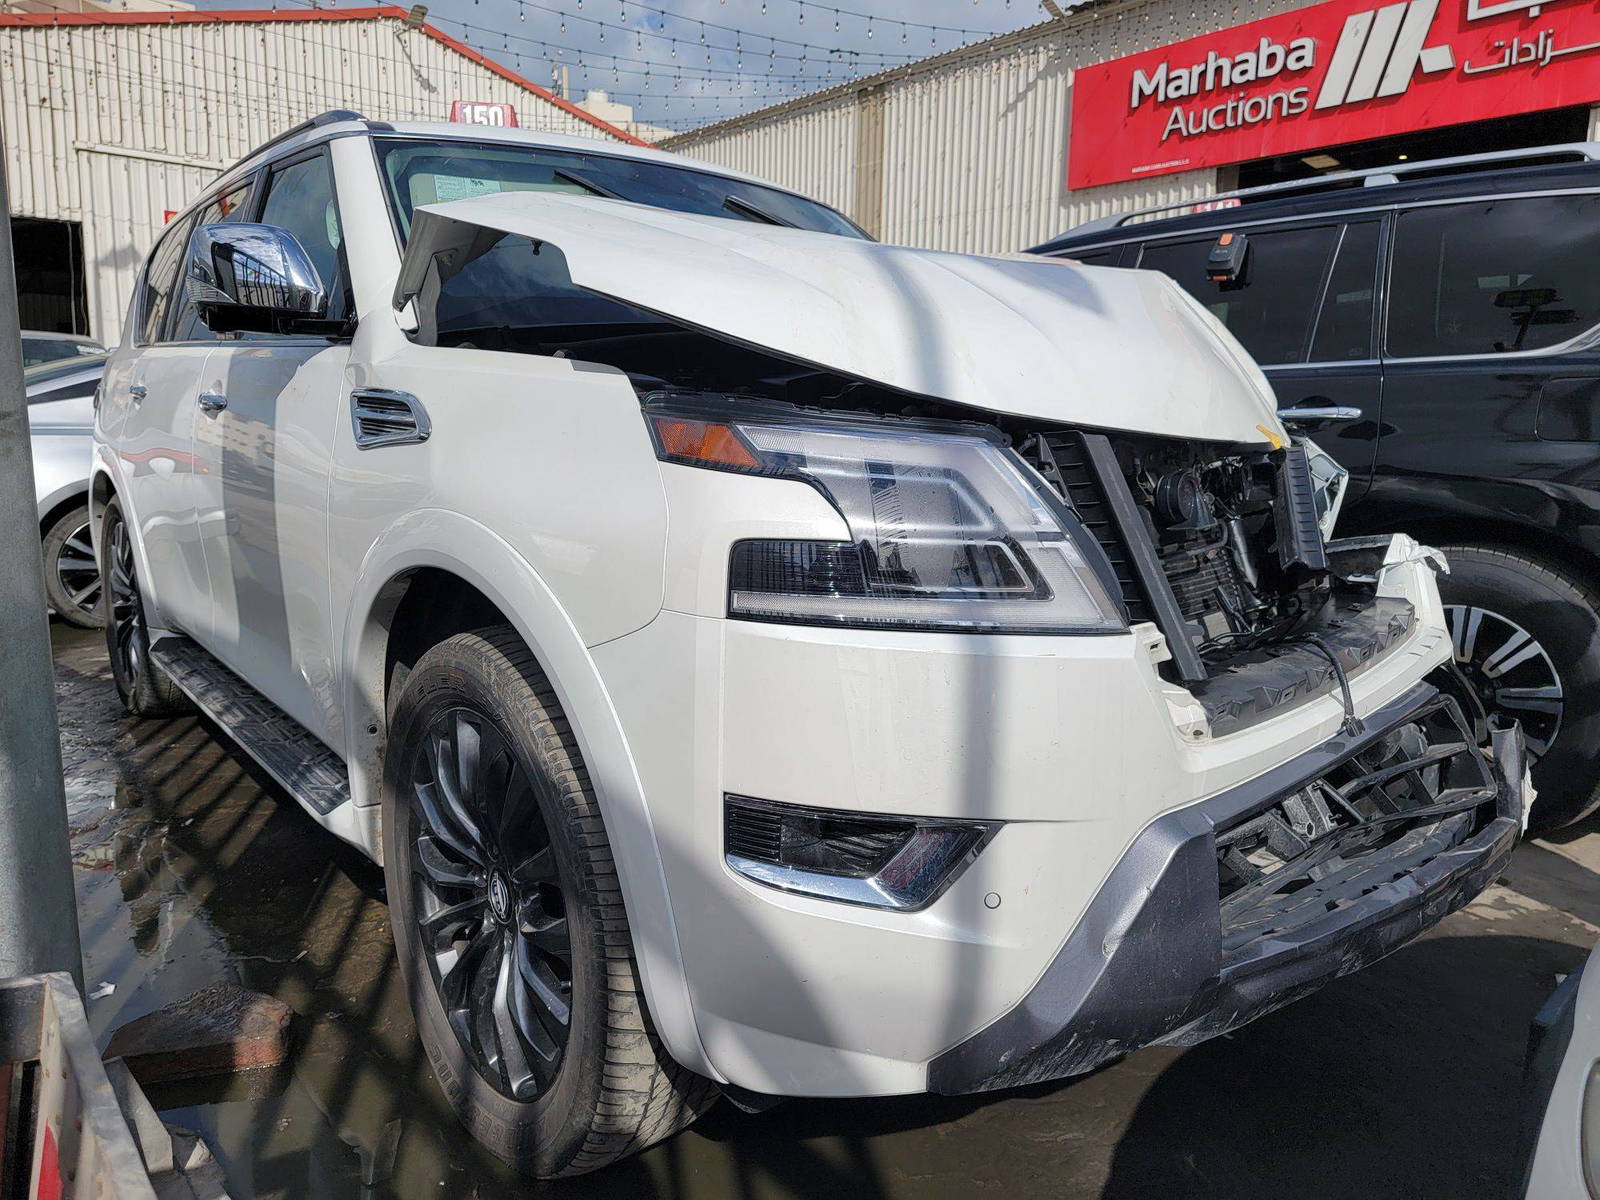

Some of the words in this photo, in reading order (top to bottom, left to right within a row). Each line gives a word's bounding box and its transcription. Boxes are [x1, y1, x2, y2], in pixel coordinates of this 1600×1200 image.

[1131, 36, 1316, 108] Marhaba
[463, 105, 504, 127] 150
[1161, 87, 1310, 141] Auctions
